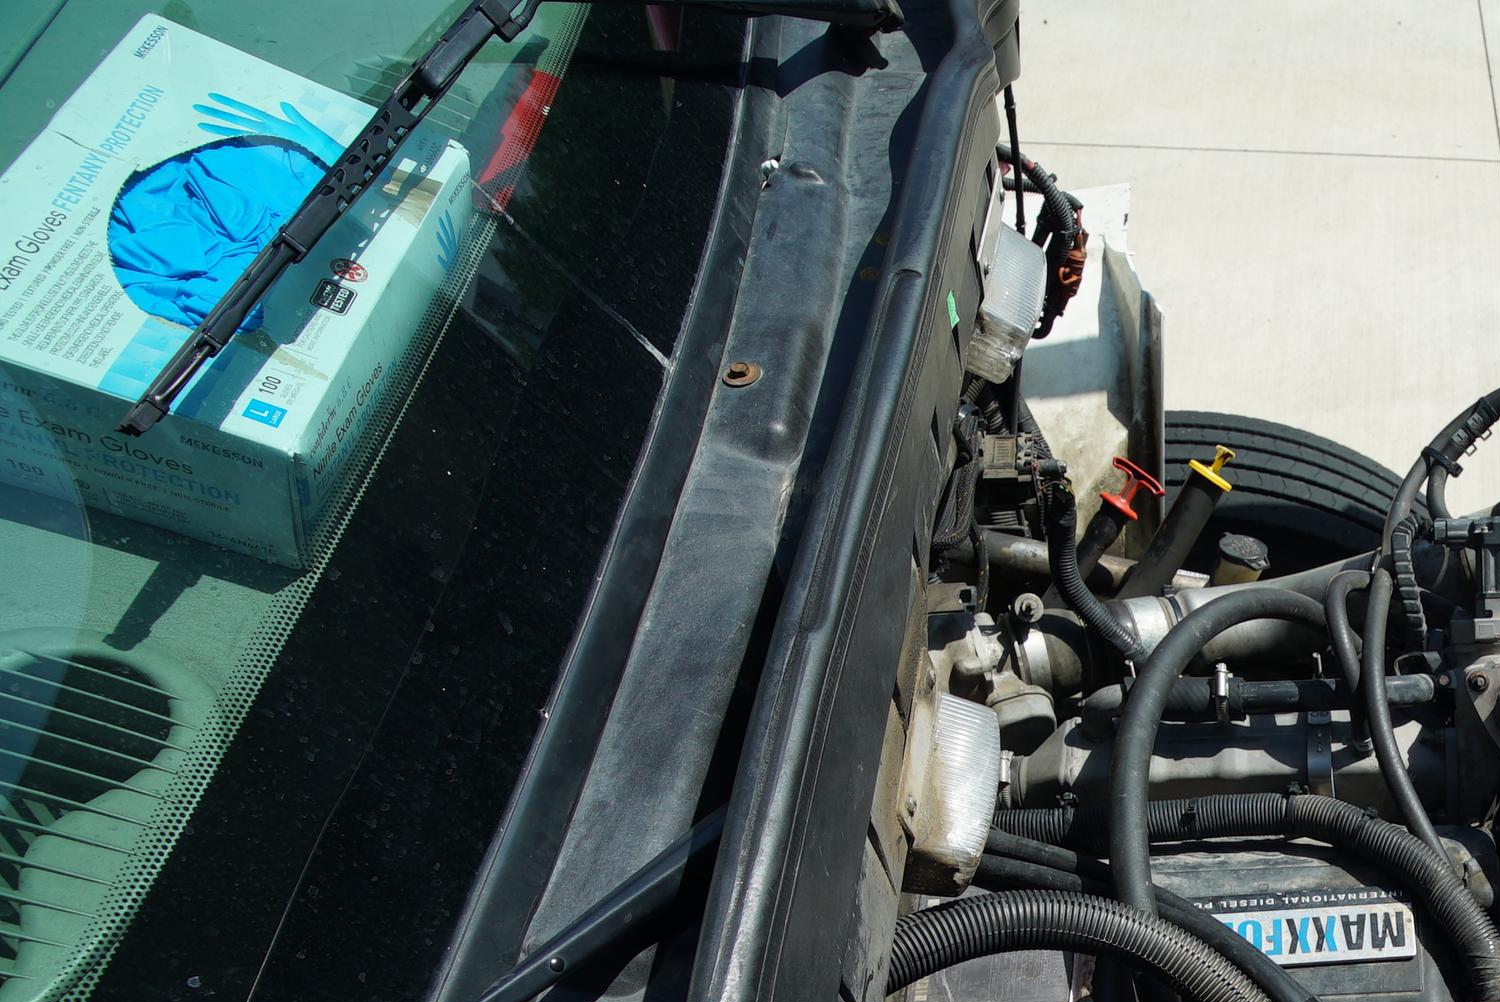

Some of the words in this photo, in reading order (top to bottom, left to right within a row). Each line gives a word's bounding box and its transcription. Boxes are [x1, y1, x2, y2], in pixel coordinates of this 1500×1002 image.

[15, 210, 67, 254] Gloves
[100, 84, 164, 155] PROTECTION
[330, 288, 350, 312] TESTED
[258, 375, 282, 395] 100
[250, 400, 270, 417] L
[313, 443, 337, 480] Nitrile
[335, 405, 358, 443] Exam
[356, 361, 383, 407] Gloves
[18, 408, 92, 444] Exam
[100, 434, 193, 475] Gloves
[7, 458, 45, 476] 100
[84, 447, 241, 506] PROTECTION
[1220, 897, 1275, 909] DIESEL
